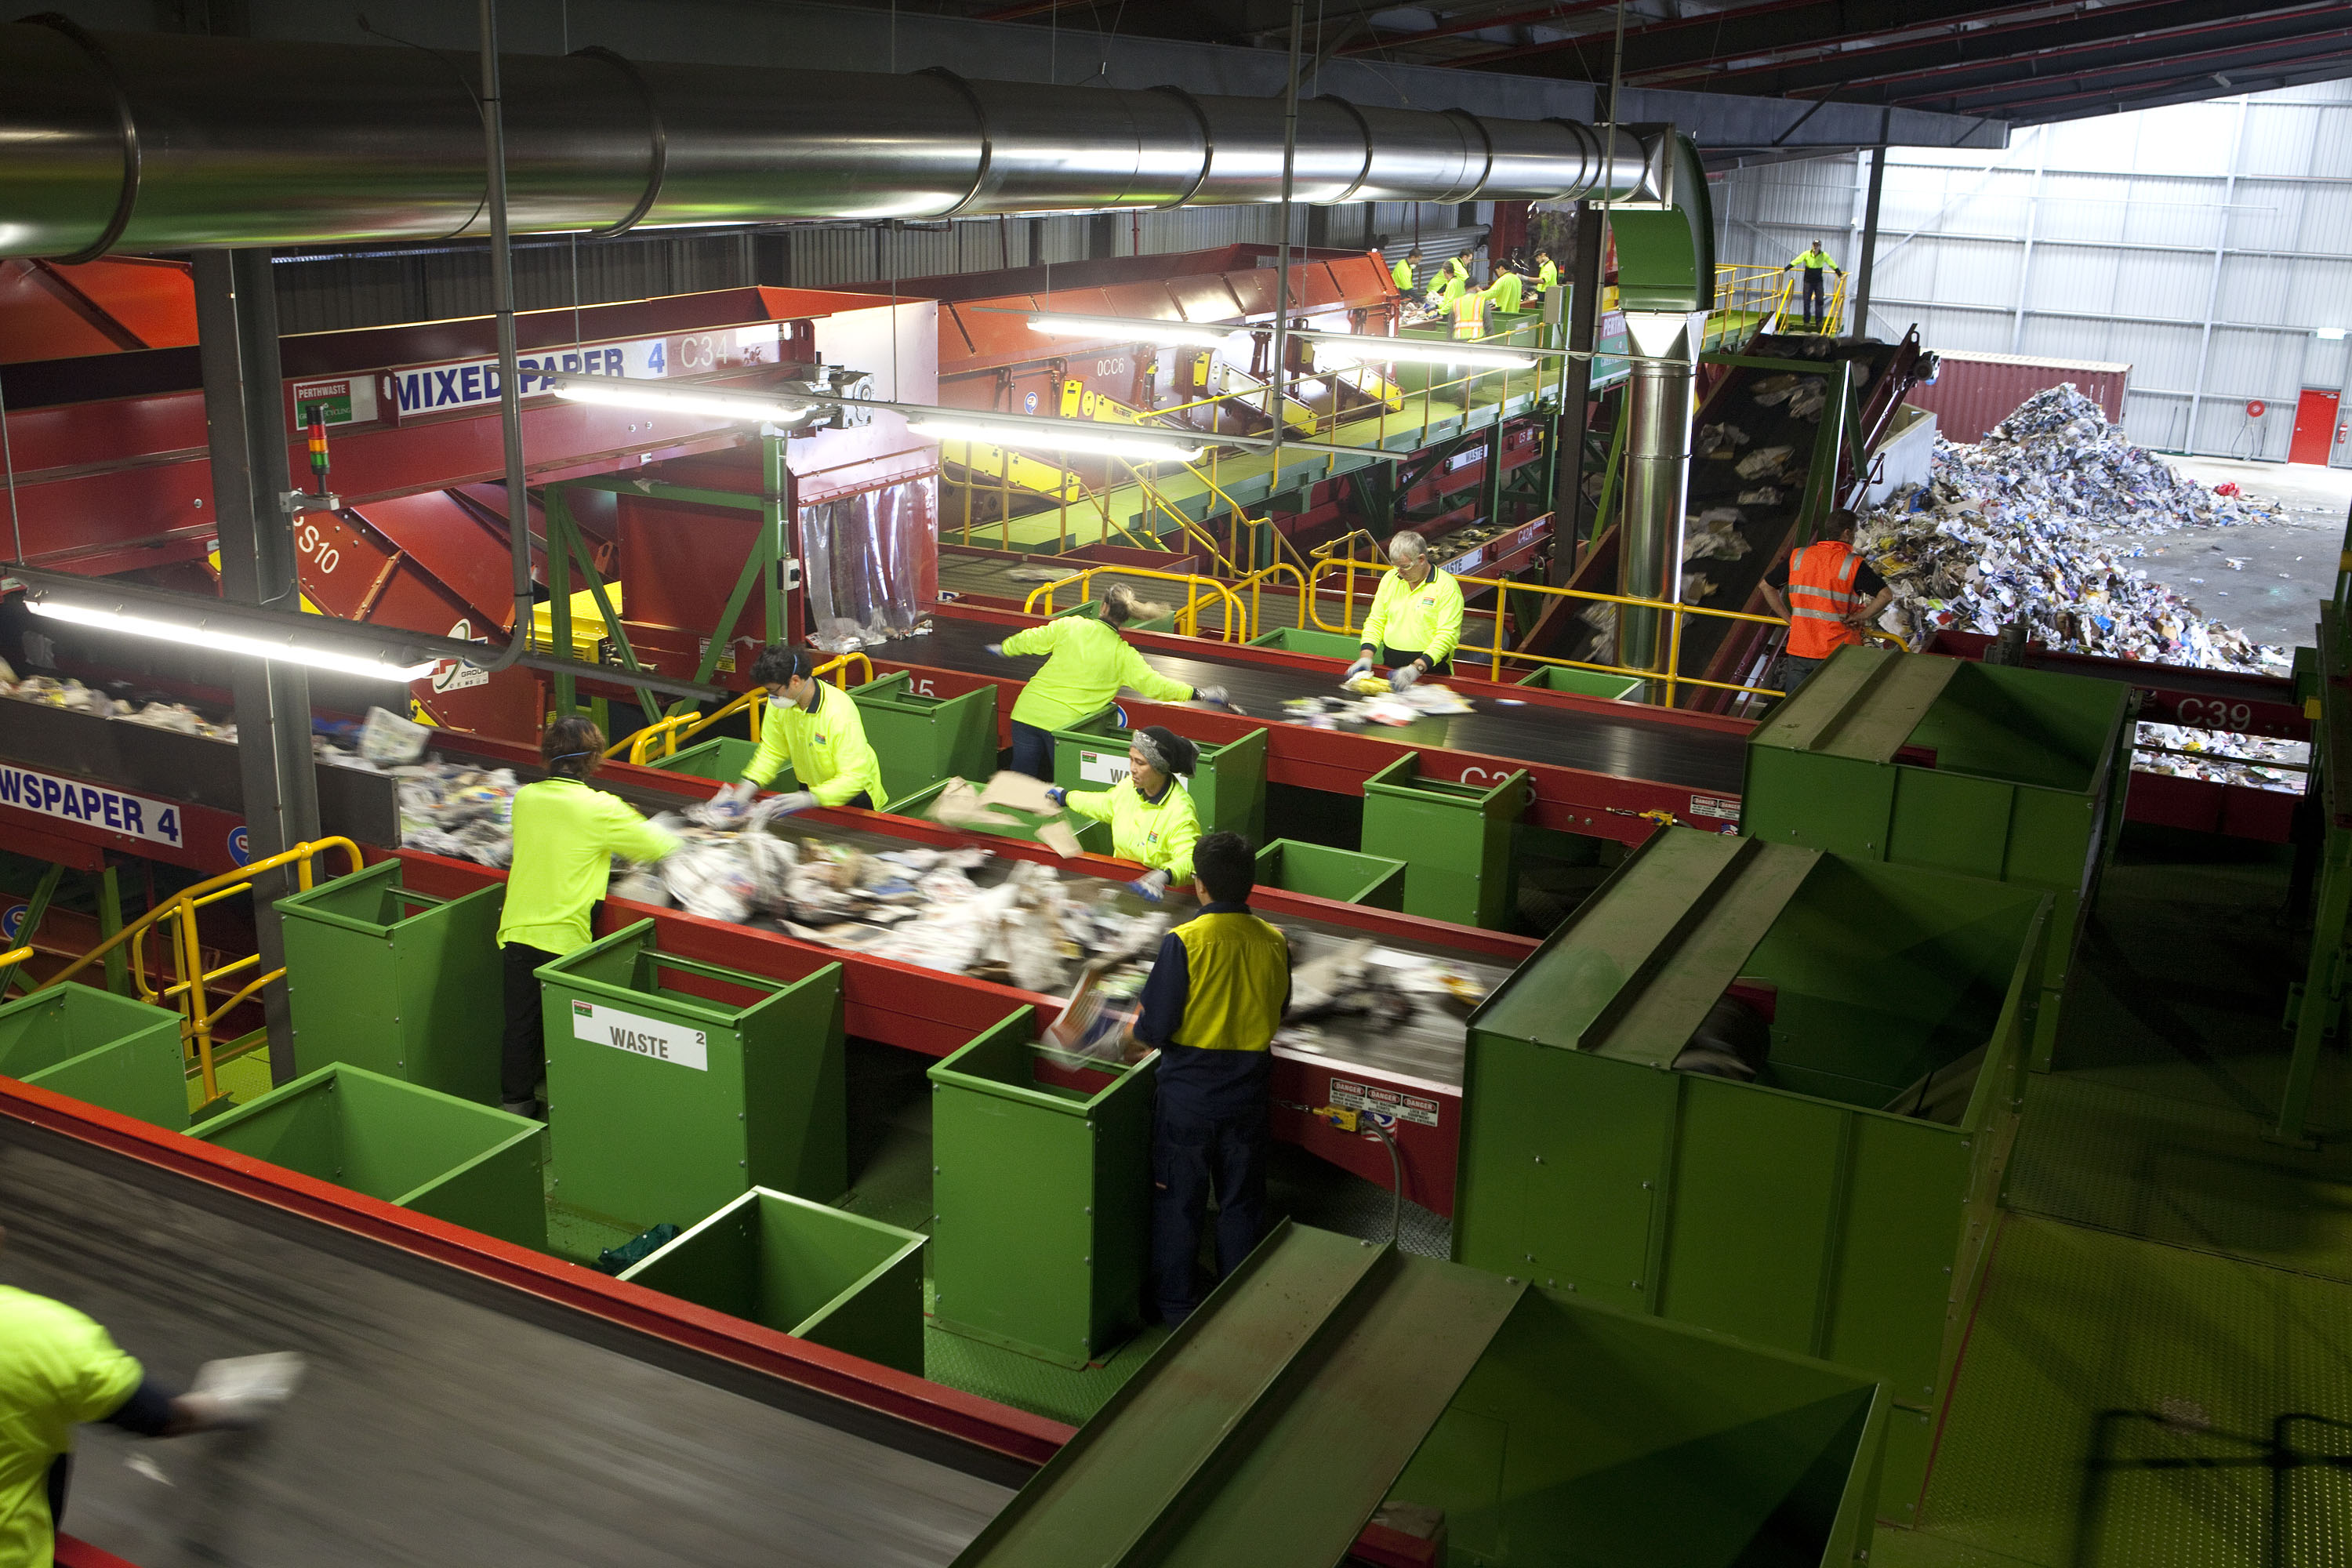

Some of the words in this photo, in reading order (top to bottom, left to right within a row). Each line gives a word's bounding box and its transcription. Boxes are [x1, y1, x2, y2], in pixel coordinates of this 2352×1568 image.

[681, 336, 728, 368] C34
[397, 365, 502, 411] MIXED
[648, 343, 665, 373] 4
[299, 384, 347, 399] PERTHWASTE
[2177, 698, 2251, 731] C39
[157, 808, 179, 842] 4
[609, 1025, 669, 1059] WASTE
[695, 1032, 705, 1045] 2
[1335, 1083, 1362, 1094] DANGER
[1371, 1091, 1396, 1102] DANGER
[1406, 1100, 1432, 1111] DANGER
